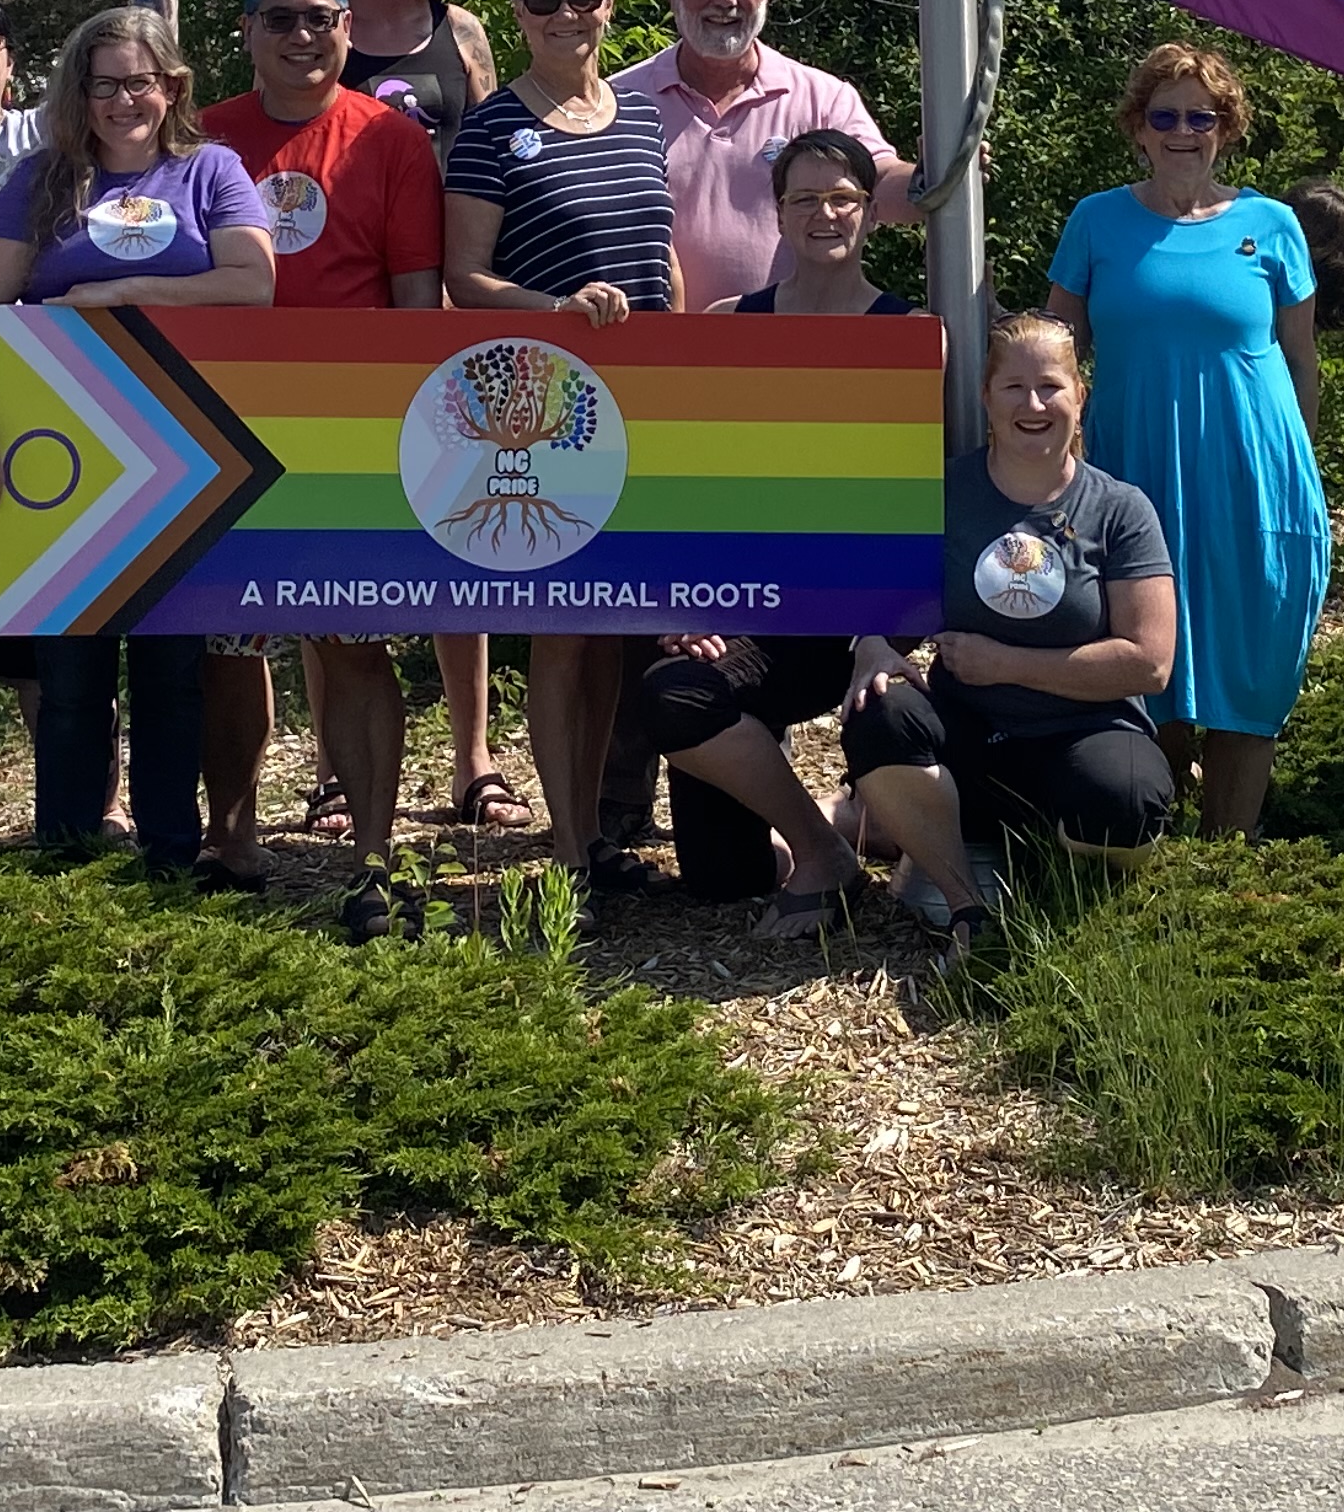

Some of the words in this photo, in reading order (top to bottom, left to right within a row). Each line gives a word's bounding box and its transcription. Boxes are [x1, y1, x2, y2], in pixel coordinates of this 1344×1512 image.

[488, 476, 538, 496] PRIDE
[239, 579, 265, 607] A
[275, 580, 439, 607] RAINBOW
[448, 580, 536, 607] WITH
[547, 580, 659, 608] RURAL
[669, 581, 782, 609] ROOTS
